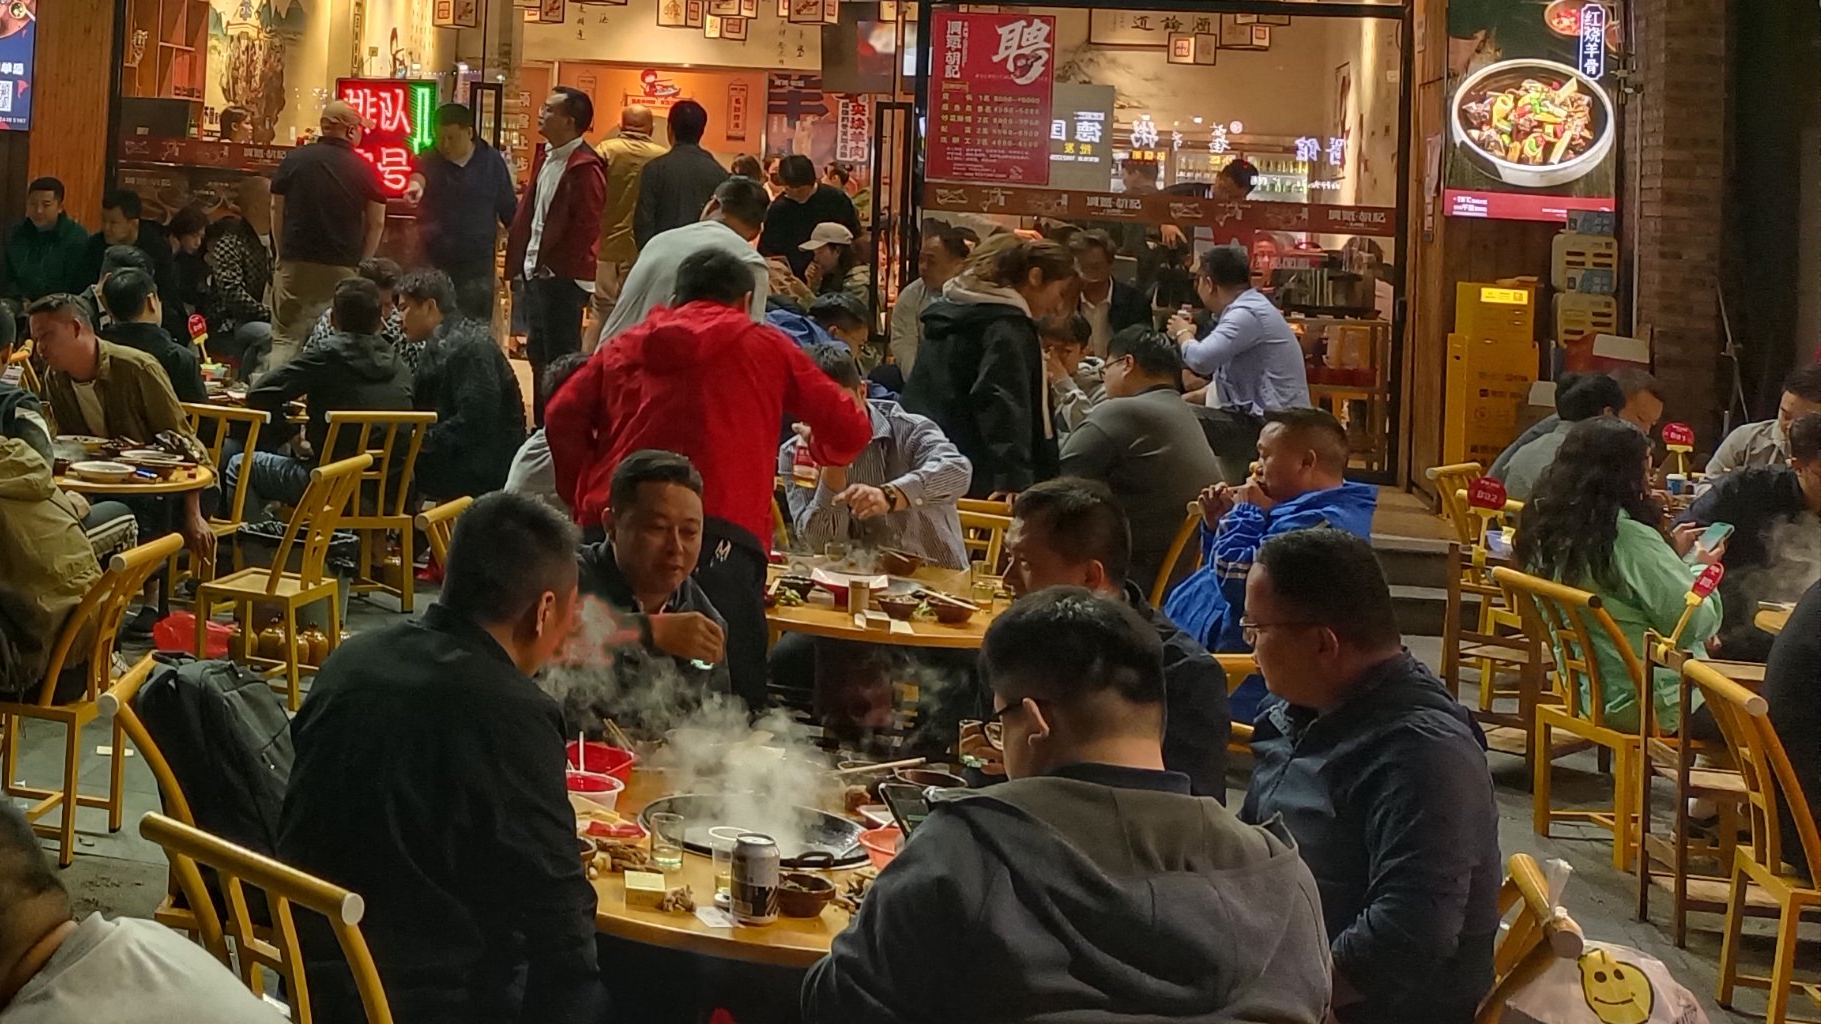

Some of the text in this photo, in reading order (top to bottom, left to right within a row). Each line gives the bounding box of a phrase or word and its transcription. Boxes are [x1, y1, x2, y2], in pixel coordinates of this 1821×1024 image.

[991, 18, 1052, 86] 聘
[1583, 10, 1602, 74] 红烧羊骨
